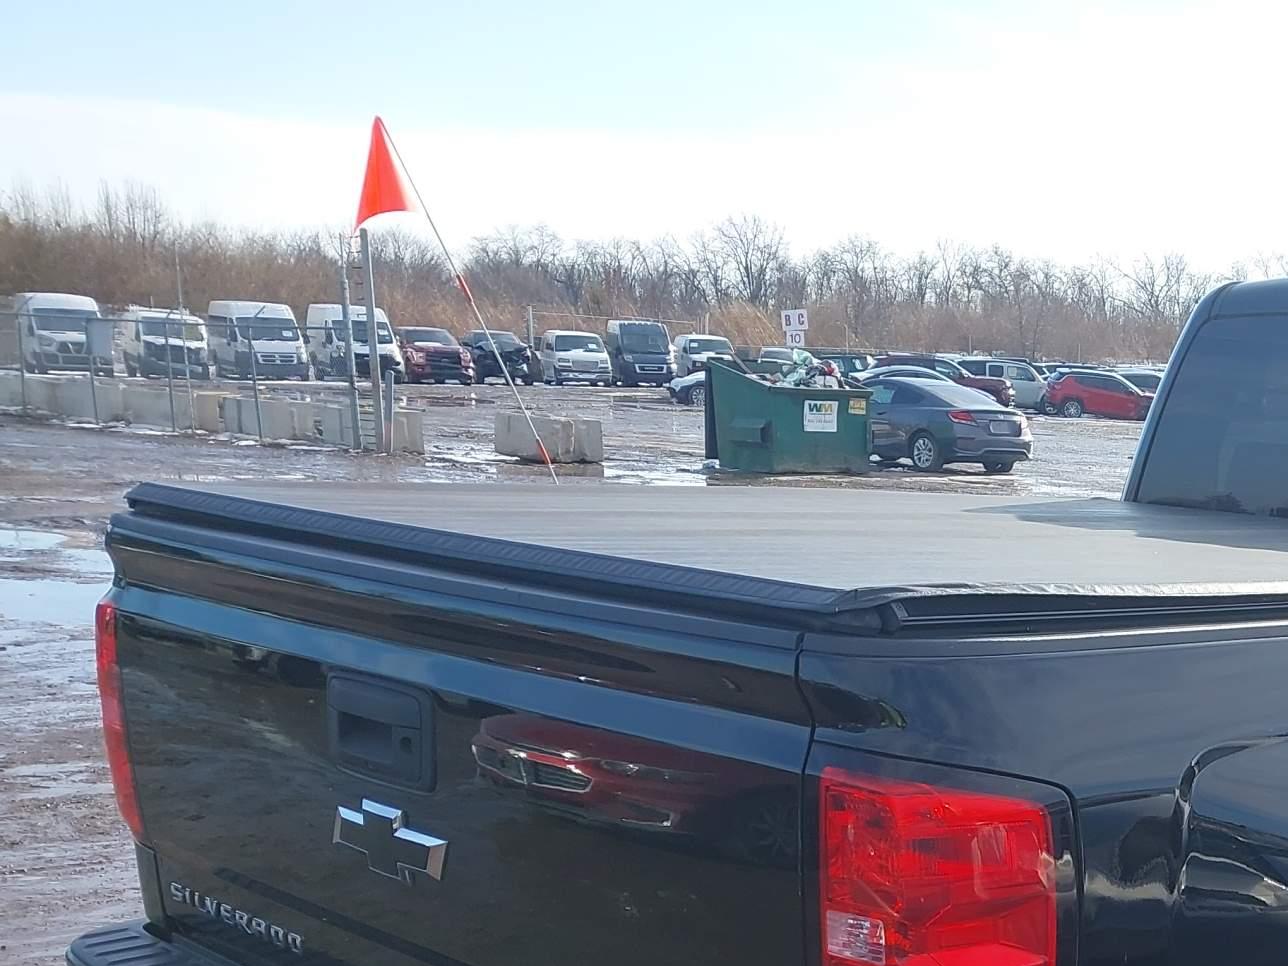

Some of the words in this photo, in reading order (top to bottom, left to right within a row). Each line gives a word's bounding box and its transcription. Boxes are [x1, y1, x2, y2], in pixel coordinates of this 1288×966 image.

[784, 314, 792, 327] B
[797, 313, 805, 326] C
[789, 333, 801, 344] 10
[808, 402, 833, 412] WM
[169, 881, 303, 954] SILVERADO
